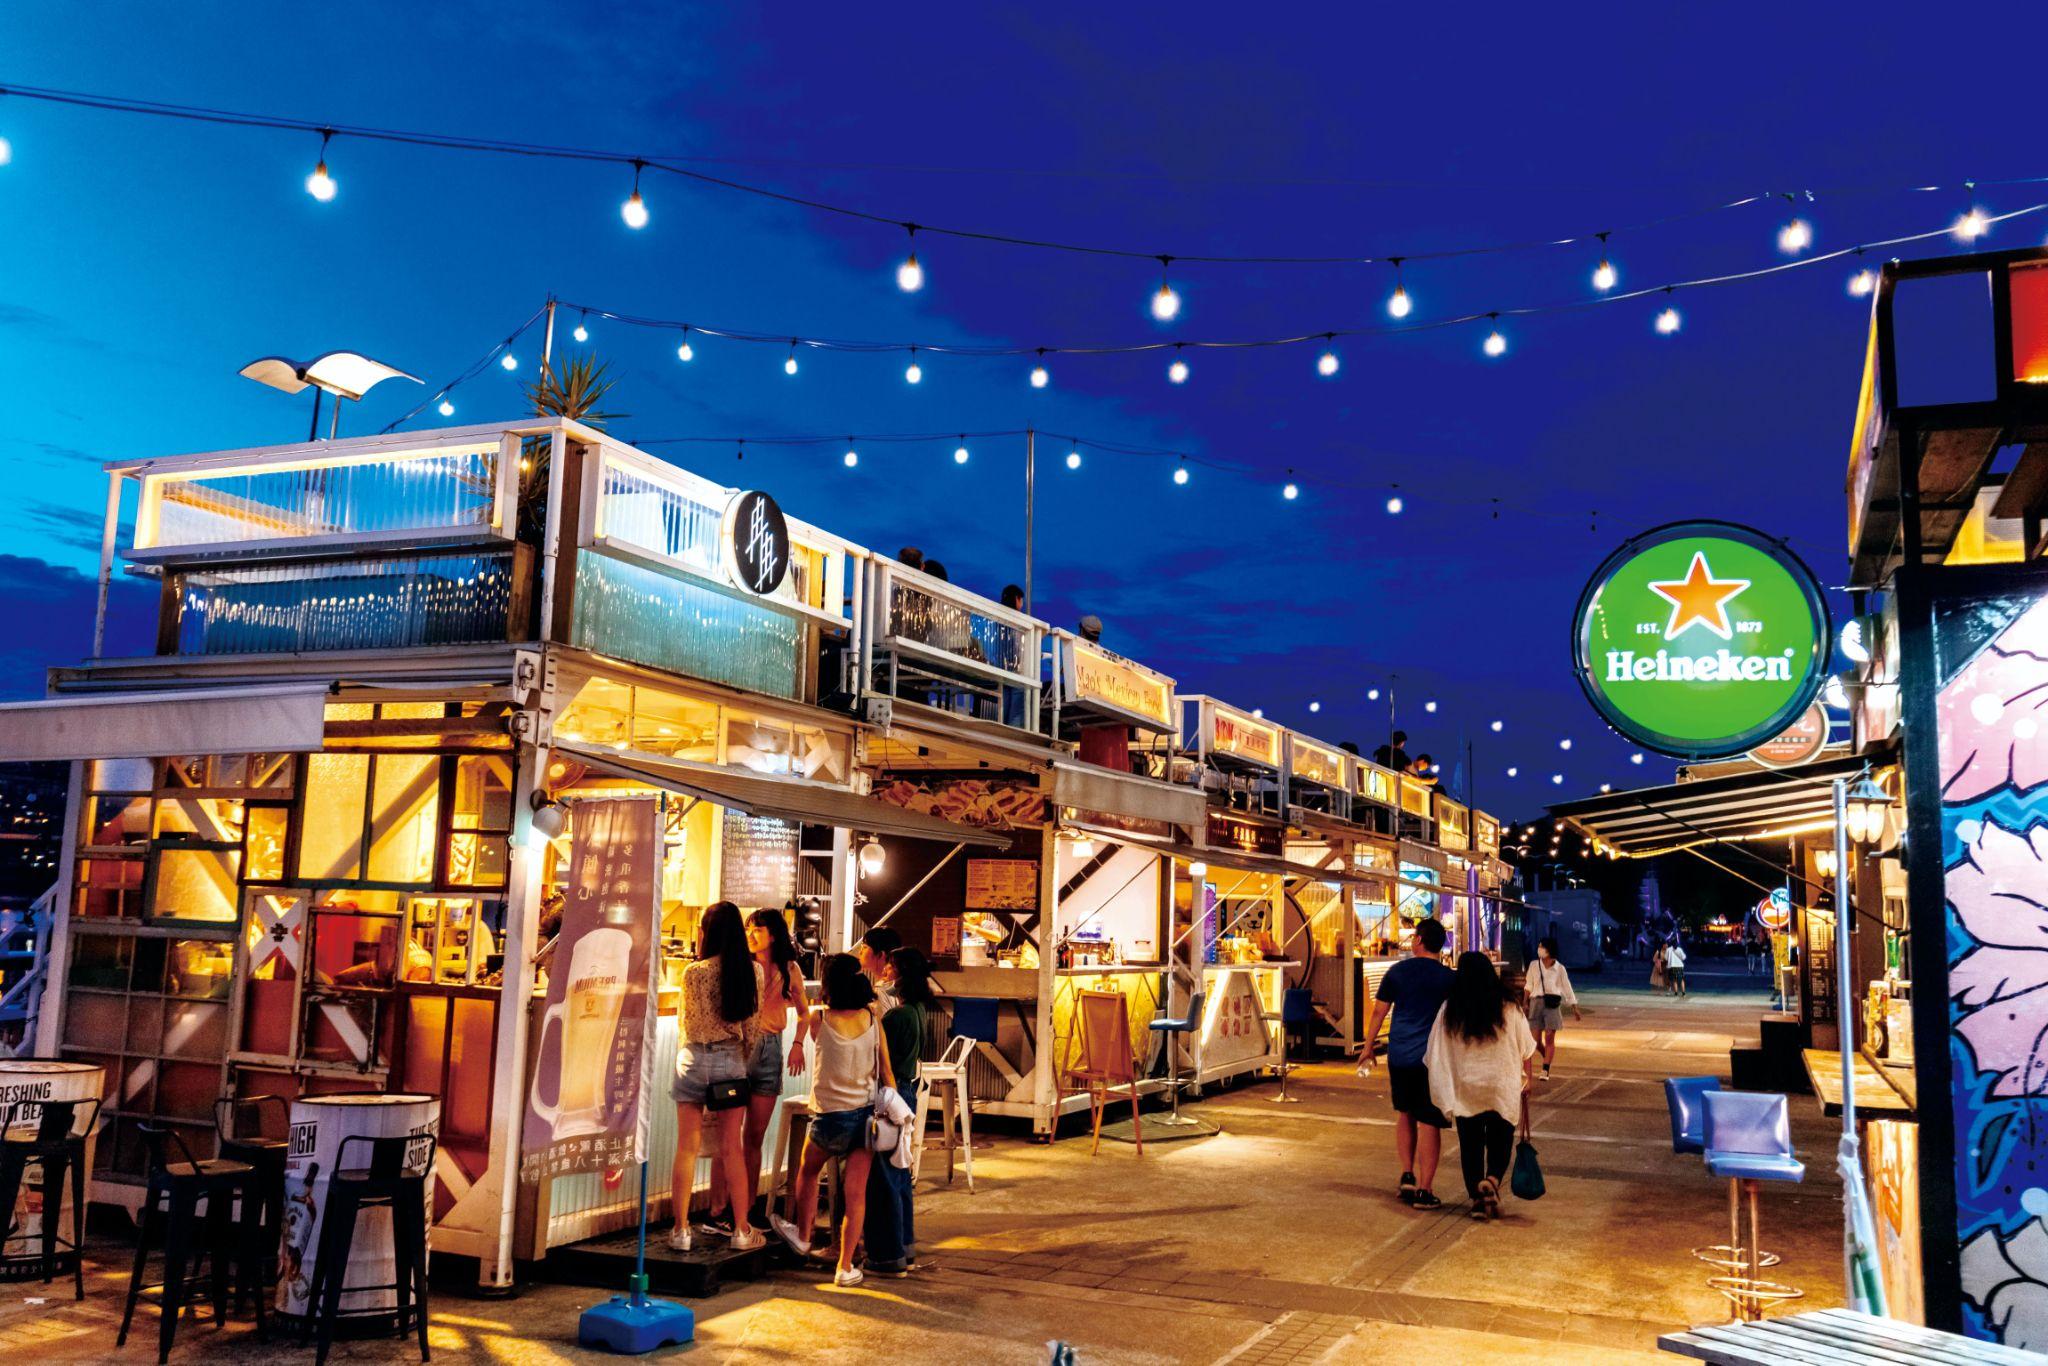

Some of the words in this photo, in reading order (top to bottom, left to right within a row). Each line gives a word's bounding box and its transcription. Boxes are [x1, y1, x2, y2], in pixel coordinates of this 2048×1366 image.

[1636, 623, 1661, 635] EST.
[1736, 621, 1763, 633] 1873
[1605, 648, 1793, 682] Heineken
[288, 1124, 318, 1154] HIGH
[408, 1146, 427, 1169] SIDE
